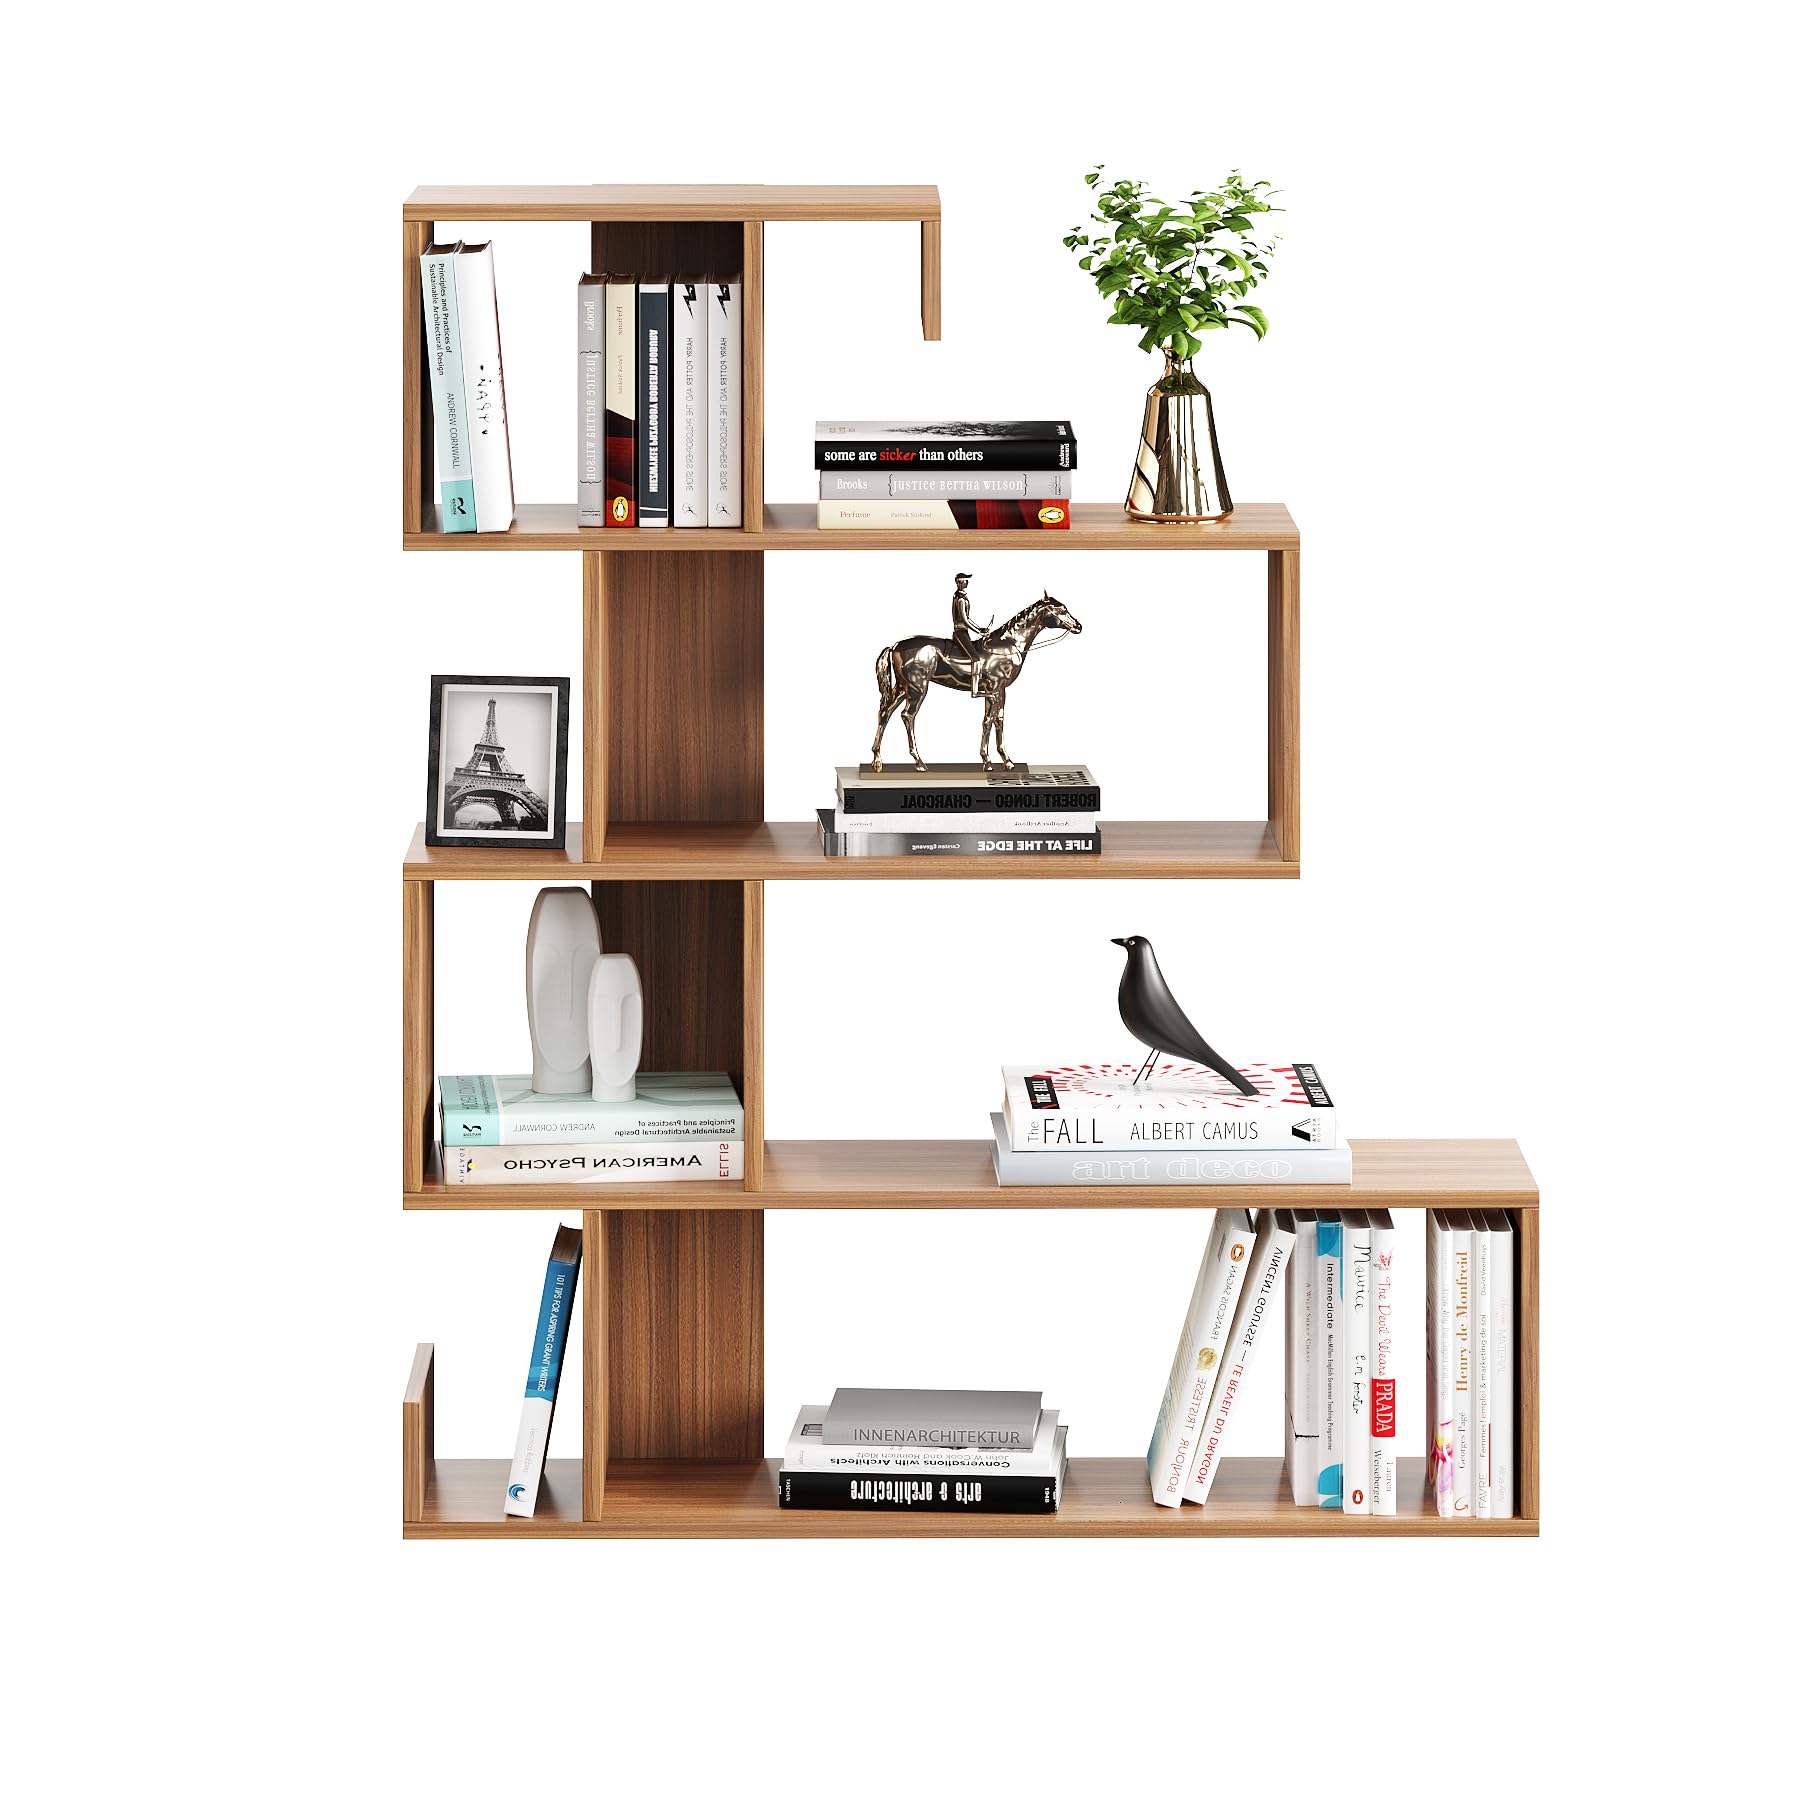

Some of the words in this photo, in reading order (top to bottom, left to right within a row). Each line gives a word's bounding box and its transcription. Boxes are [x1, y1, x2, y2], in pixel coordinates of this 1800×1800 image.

[430, 264, 441, 304] Sustainable
[437, 264, 446, 296] Principles
[445, 342, 452, 352] of
[433, 305, 445, 350] Architectural
[447, 393, 456, 425] ANDREW
[450, 428, 460, 469] CORNWALL
[825, 452, 855, 461] some
[859, 452, 877, 461] are
[880, 448, 916, 461] sicker
[919, 448, 944, 460] than
[948, 448, 983, 460] others
[838, 479, 867, 490] Brooks
[1044, 1119, 1103, 1143] FALL
[1131, 1123, 1194, 1140] ALBERT
[1203, 1122, 1258, 1139] CAMUS
[1071, 1157, 1153, 1181] art
[1166, 1157, 1293, 1181] deco
[556, 1274, 565, 1286] 101
[1354, 1243, 1373, 1310] Maurice
[1456, 1252, 1467, 1317] Monfreid
[554, 1286, 564, 1300] TIPS
[1376, 1277, 1390, 1302] The
[552, 1299, 562, 1312] FOR
[546, 1312, 559, 1343] ASPIRING
[1378, 1305, 1391, 1334] Devil
[1456, 1324, 1467, 1341] de
[1480, 1328, 1486, 1338] de
[541, 1343, 553, 1368] GRANT
[1377, 1338, 1391, 1376] Wears
[536, 1367, 549, 1391] WRITERS
[1456, 1349, 1472, 1390] Henry
[1376, 1382, 1393, 1432] PRADA
[1458, 1412, 1467, 1431] Pagé
[852, 1428, 1021, 1445] INNENARCHITEKTUR
[831, 1457, 890, 1465] Architects
[896, 1458, 919, 1466] with
[924, 1458, 1010, 1468] Conversations
[1458, 1435, 1467, 1468] Georges
[850, 1479, 933, 1505] architecture
[955, 1480, 982, 1503] arts
[1478, 1473, 1489, 1510] FAVRE
